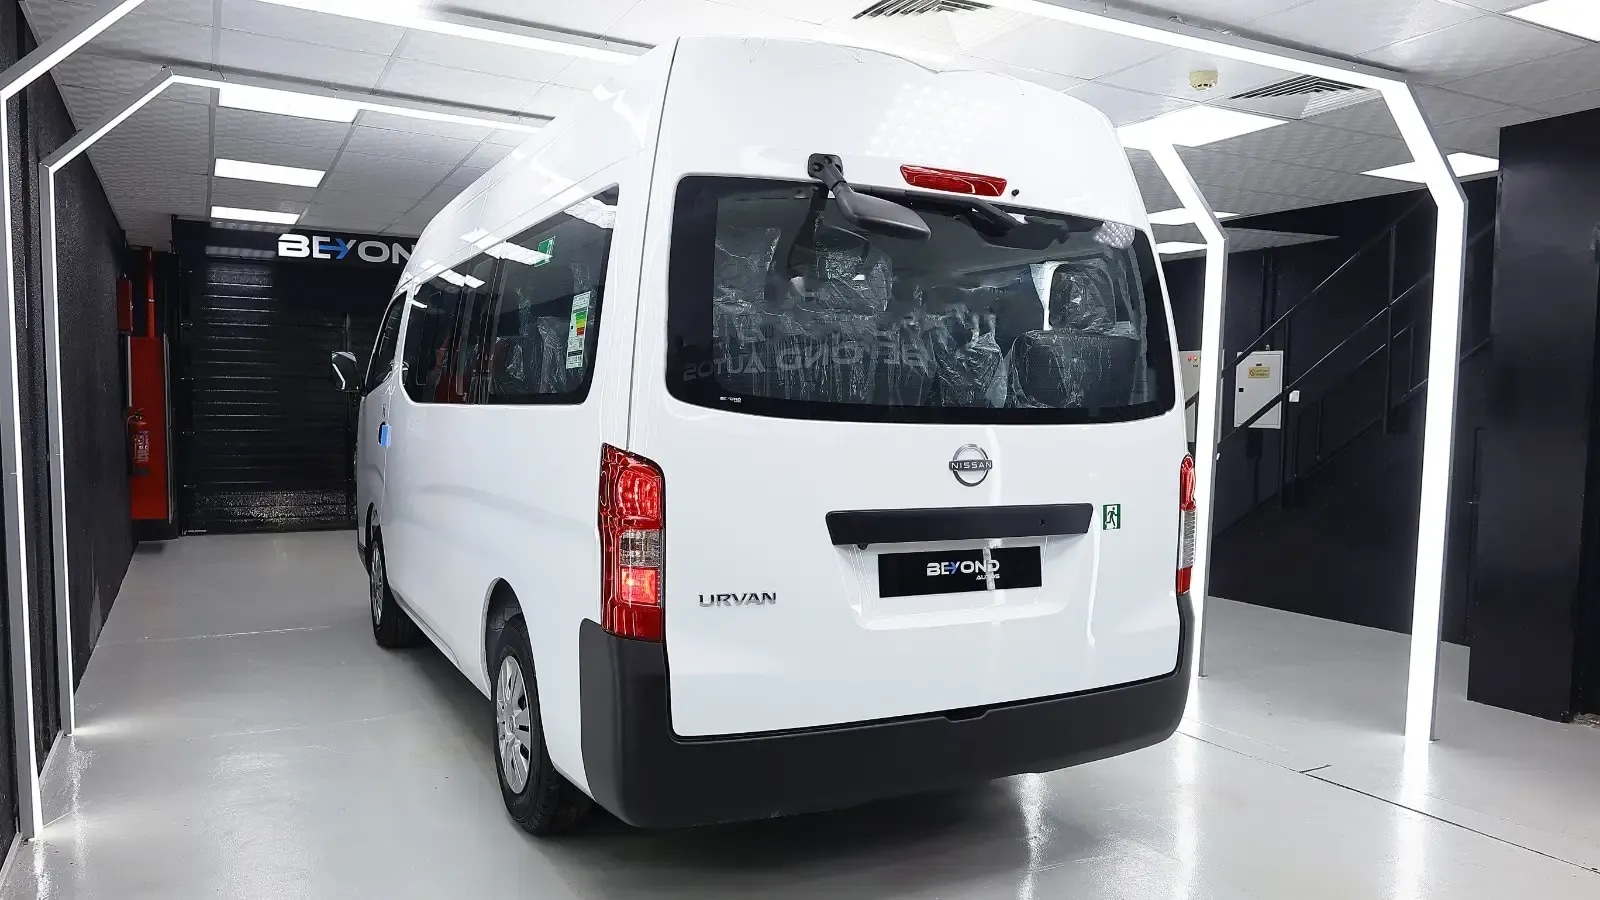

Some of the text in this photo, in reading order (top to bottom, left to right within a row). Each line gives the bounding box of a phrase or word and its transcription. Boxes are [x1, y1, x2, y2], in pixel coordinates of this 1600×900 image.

[951, 461, 992, 469] NISSAN
[926, 559, 1000, 577] BEYOND
[698, 592, 776, 608] URVAN
